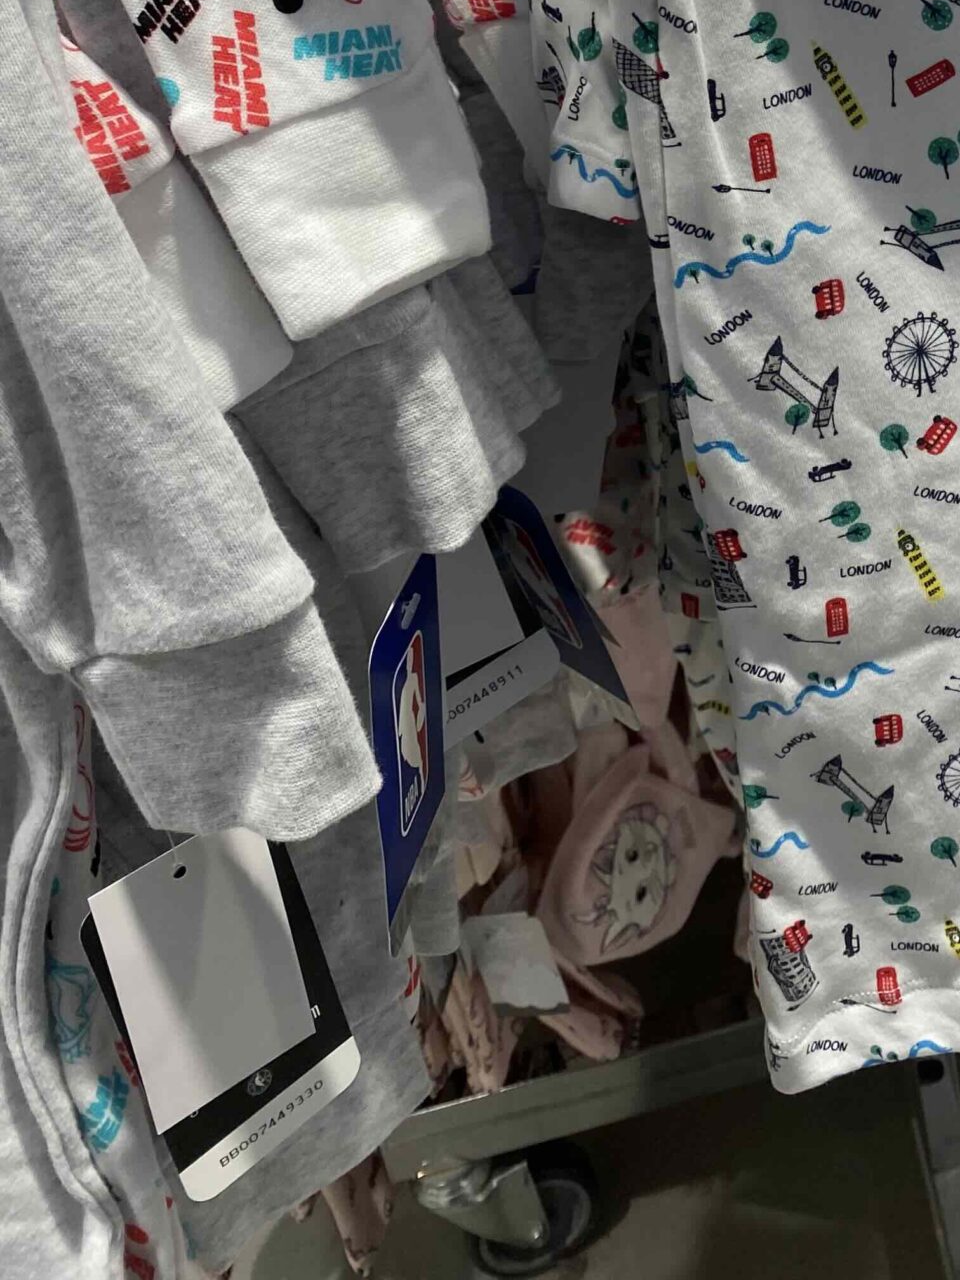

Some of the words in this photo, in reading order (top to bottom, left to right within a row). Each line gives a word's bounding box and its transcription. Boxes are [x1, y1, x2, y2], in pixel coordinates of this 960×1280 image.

[658, 6, 699, 34] ONDO
[293, 24, 393, 61] MIAMI
[233, 10, 272, 128] MIAMI
[212, 35, 249, 136] HEAT
[567, 75, 589, 121] LONDO
[763, 83, 812, 110] LONDON
[70, 80, 150, 161] HEAT
[852, 163, 903, 185] LONDON
[666, 215, 715, 242] ONDON
[855, 271, 890, 314] LONDON
[703, 309, 753, 347] LONDON
[728, 496, 783, 520] LONDON
[840, 558, 892, 578] LONDON
[734, 657, 786, 684] LONDON
[916, 709, 948, 745] LONDON
[775, 731, 817, 760] LONDON
[798, 881, 839, 896] LONDON
[890, 942, 940, 953] LONDON
[806, 1041, 848, 1055] LONDON
[218, 1079, 324, 1168] BB007449330
